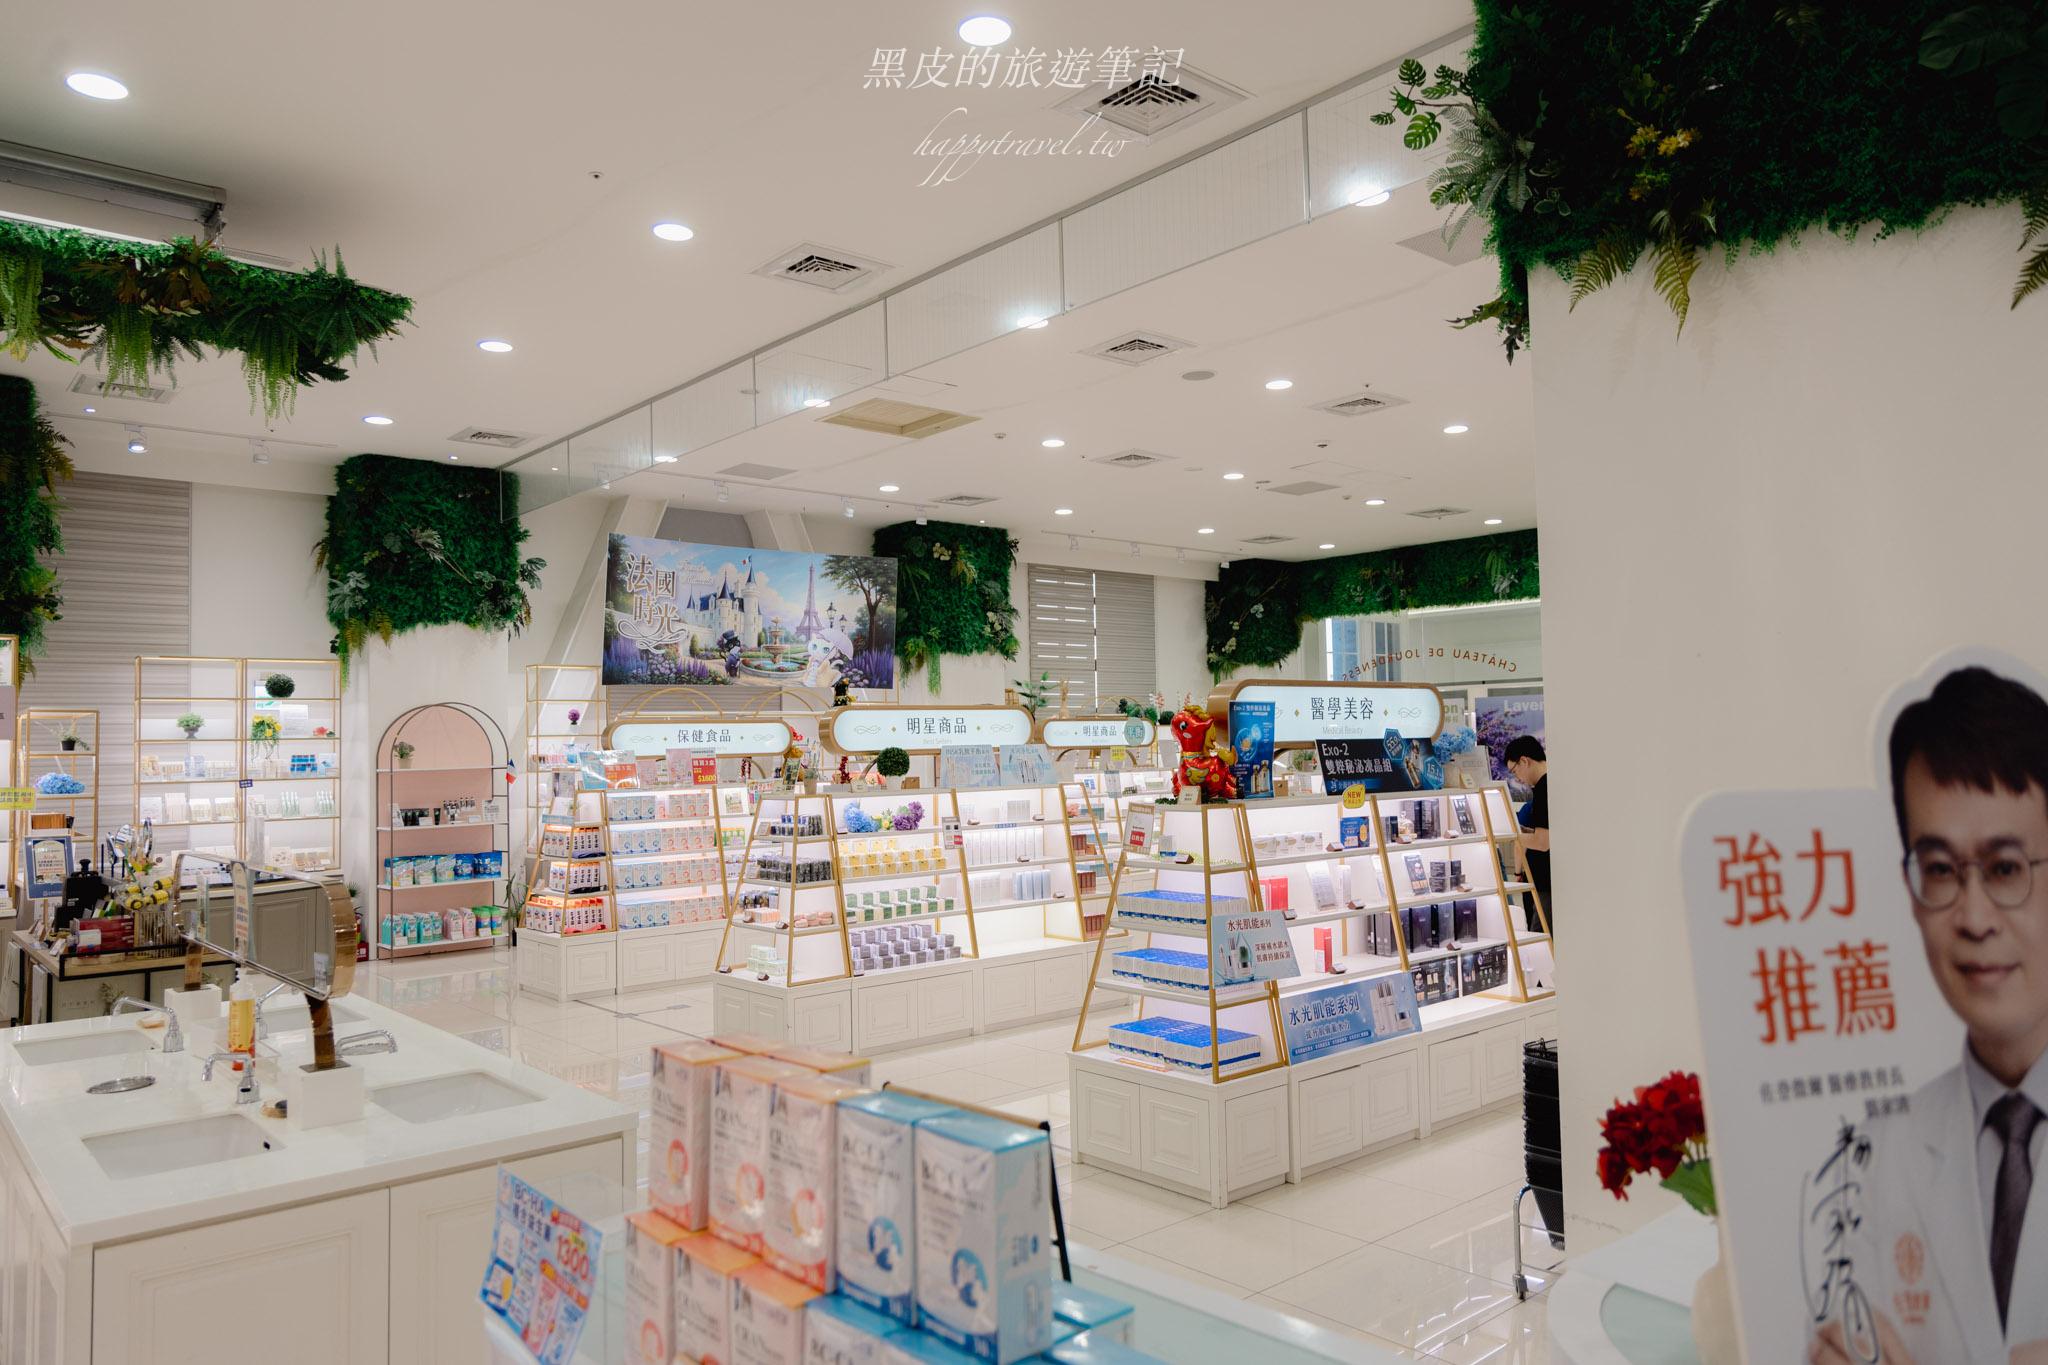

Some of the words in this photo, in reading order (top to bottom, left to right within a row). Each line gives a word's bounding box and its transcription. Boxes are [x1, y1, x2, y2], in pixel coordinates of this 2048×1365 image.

[626, 553, 676, 598] 法國
[1310, 696, 1375, 721] 醫學美容
[677, 729, 731, 743] 保健食品
[907, 716, 968, 735] 明星商品
[1082, 725, 1117, 737] 明星商品
[1321, 743, 1350, 756] Exo-2
[1713, 828, 1857, 927] 強力
[1227, 917, 1272, 932] 水光肌能系列
[1751, 939, 1898, 1046] 推薦
[1289, 993, 1361, 1026] 水光肌能系列
